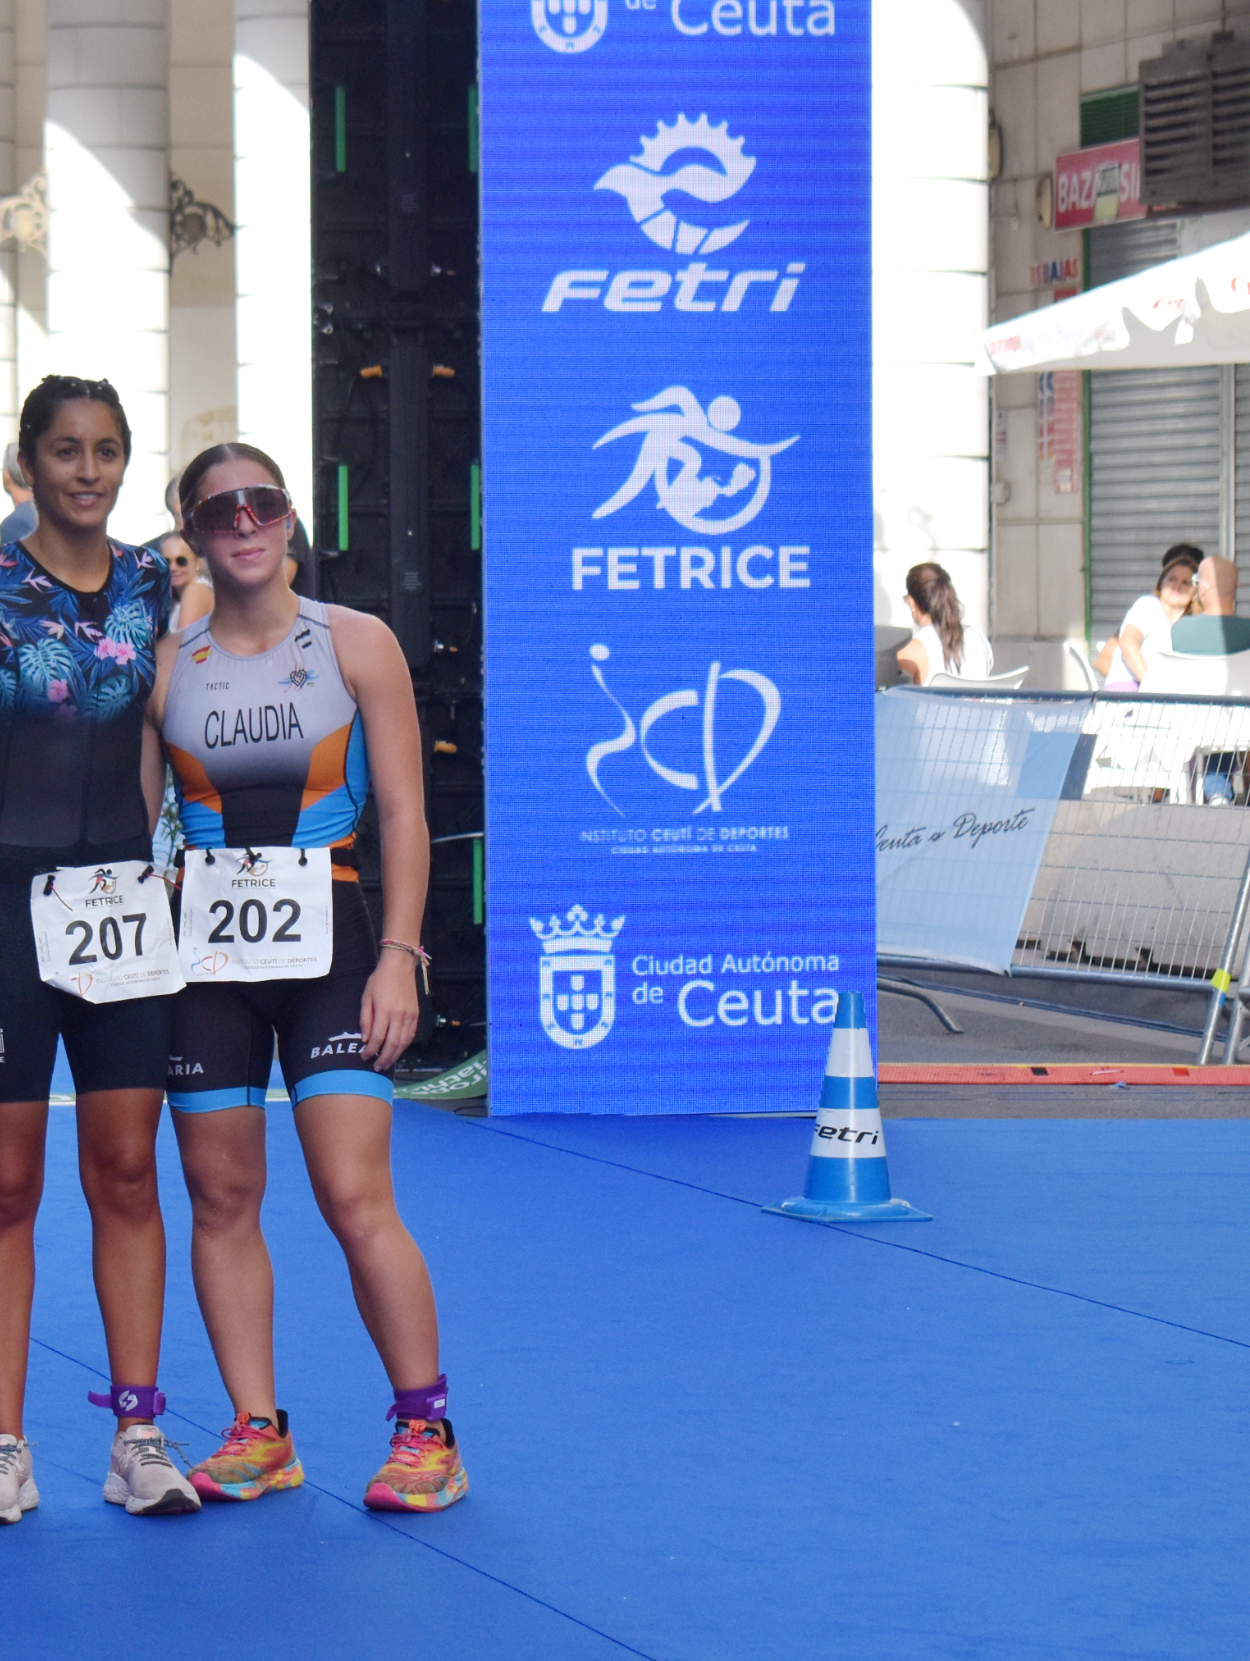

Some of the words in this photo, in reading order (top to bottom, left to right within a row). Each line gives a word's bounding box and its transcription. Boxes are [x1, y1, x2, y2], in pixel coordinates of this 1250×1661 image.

[671, 0, 836, 36] Ceuta
[572, 545, 811, 591] FETRICE
[206, 681, 230, 691] TACTIC
[204, 702, 304, 749] CLAUDIA
[697, 828, 715, 841] DE
[720, 826, 789, 841] DEPORTES
[953, 807, 1035, 849] Deporte
[85, 895, 124, 908] FETRICE
[231, 879, 276, 888] FETRICE
[65, 912, 147, 966] 207
[208, 898, 302, 944] 202
[632, 954, 712, 976] Ciudad
[722, 950, 839, 975] Autónoma
[632, 982, 663, 1005] de
[677, 979, 839, 1027] Ceuta
[311, 1043, 378, 1059] BALE
